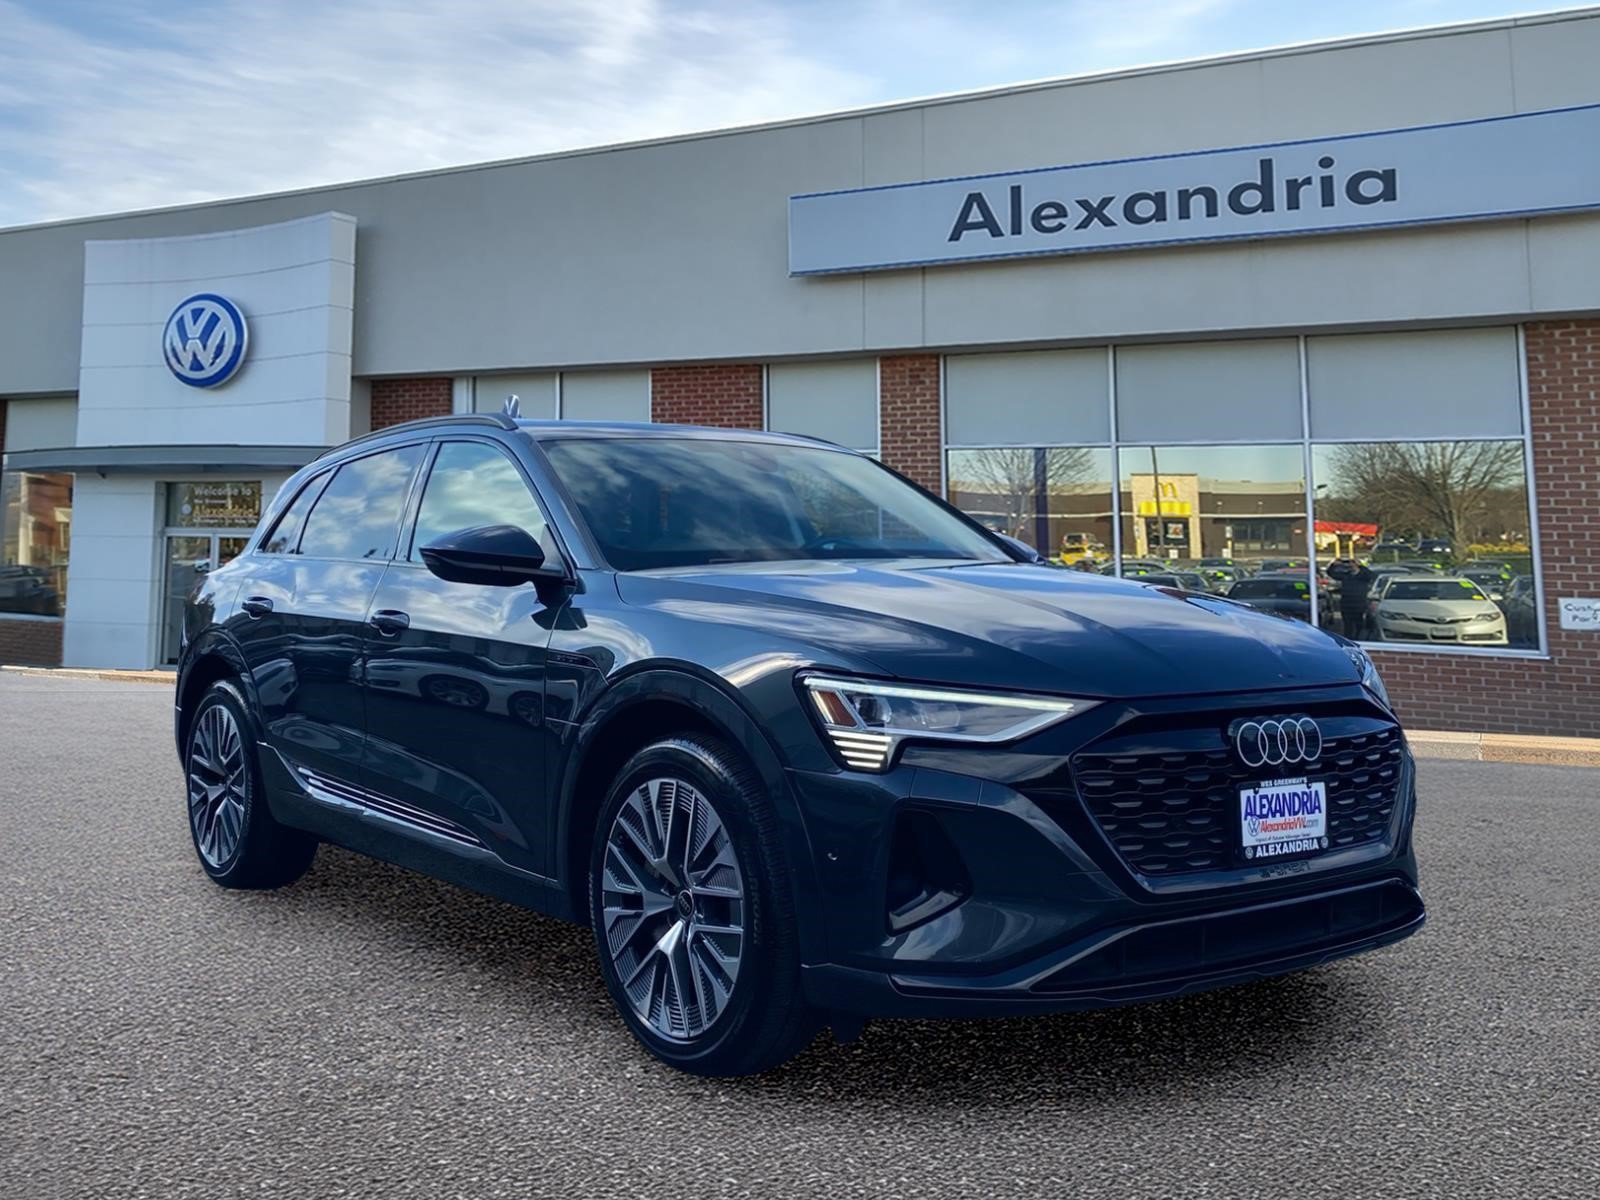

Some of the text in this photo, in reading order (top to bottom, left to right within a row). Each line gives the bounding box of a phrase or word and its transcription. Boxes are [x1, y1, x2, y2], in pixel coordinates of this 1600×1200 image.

[947, 156, 1398, 242] Alexandria
[165, 297, 244, 384] VW
[194, 486, 252, 496] Welcome to
[1244, 790, 1322, 821] ALEXANDRIA
[1256, 838, 1320, 858] ALEXANDRIA
